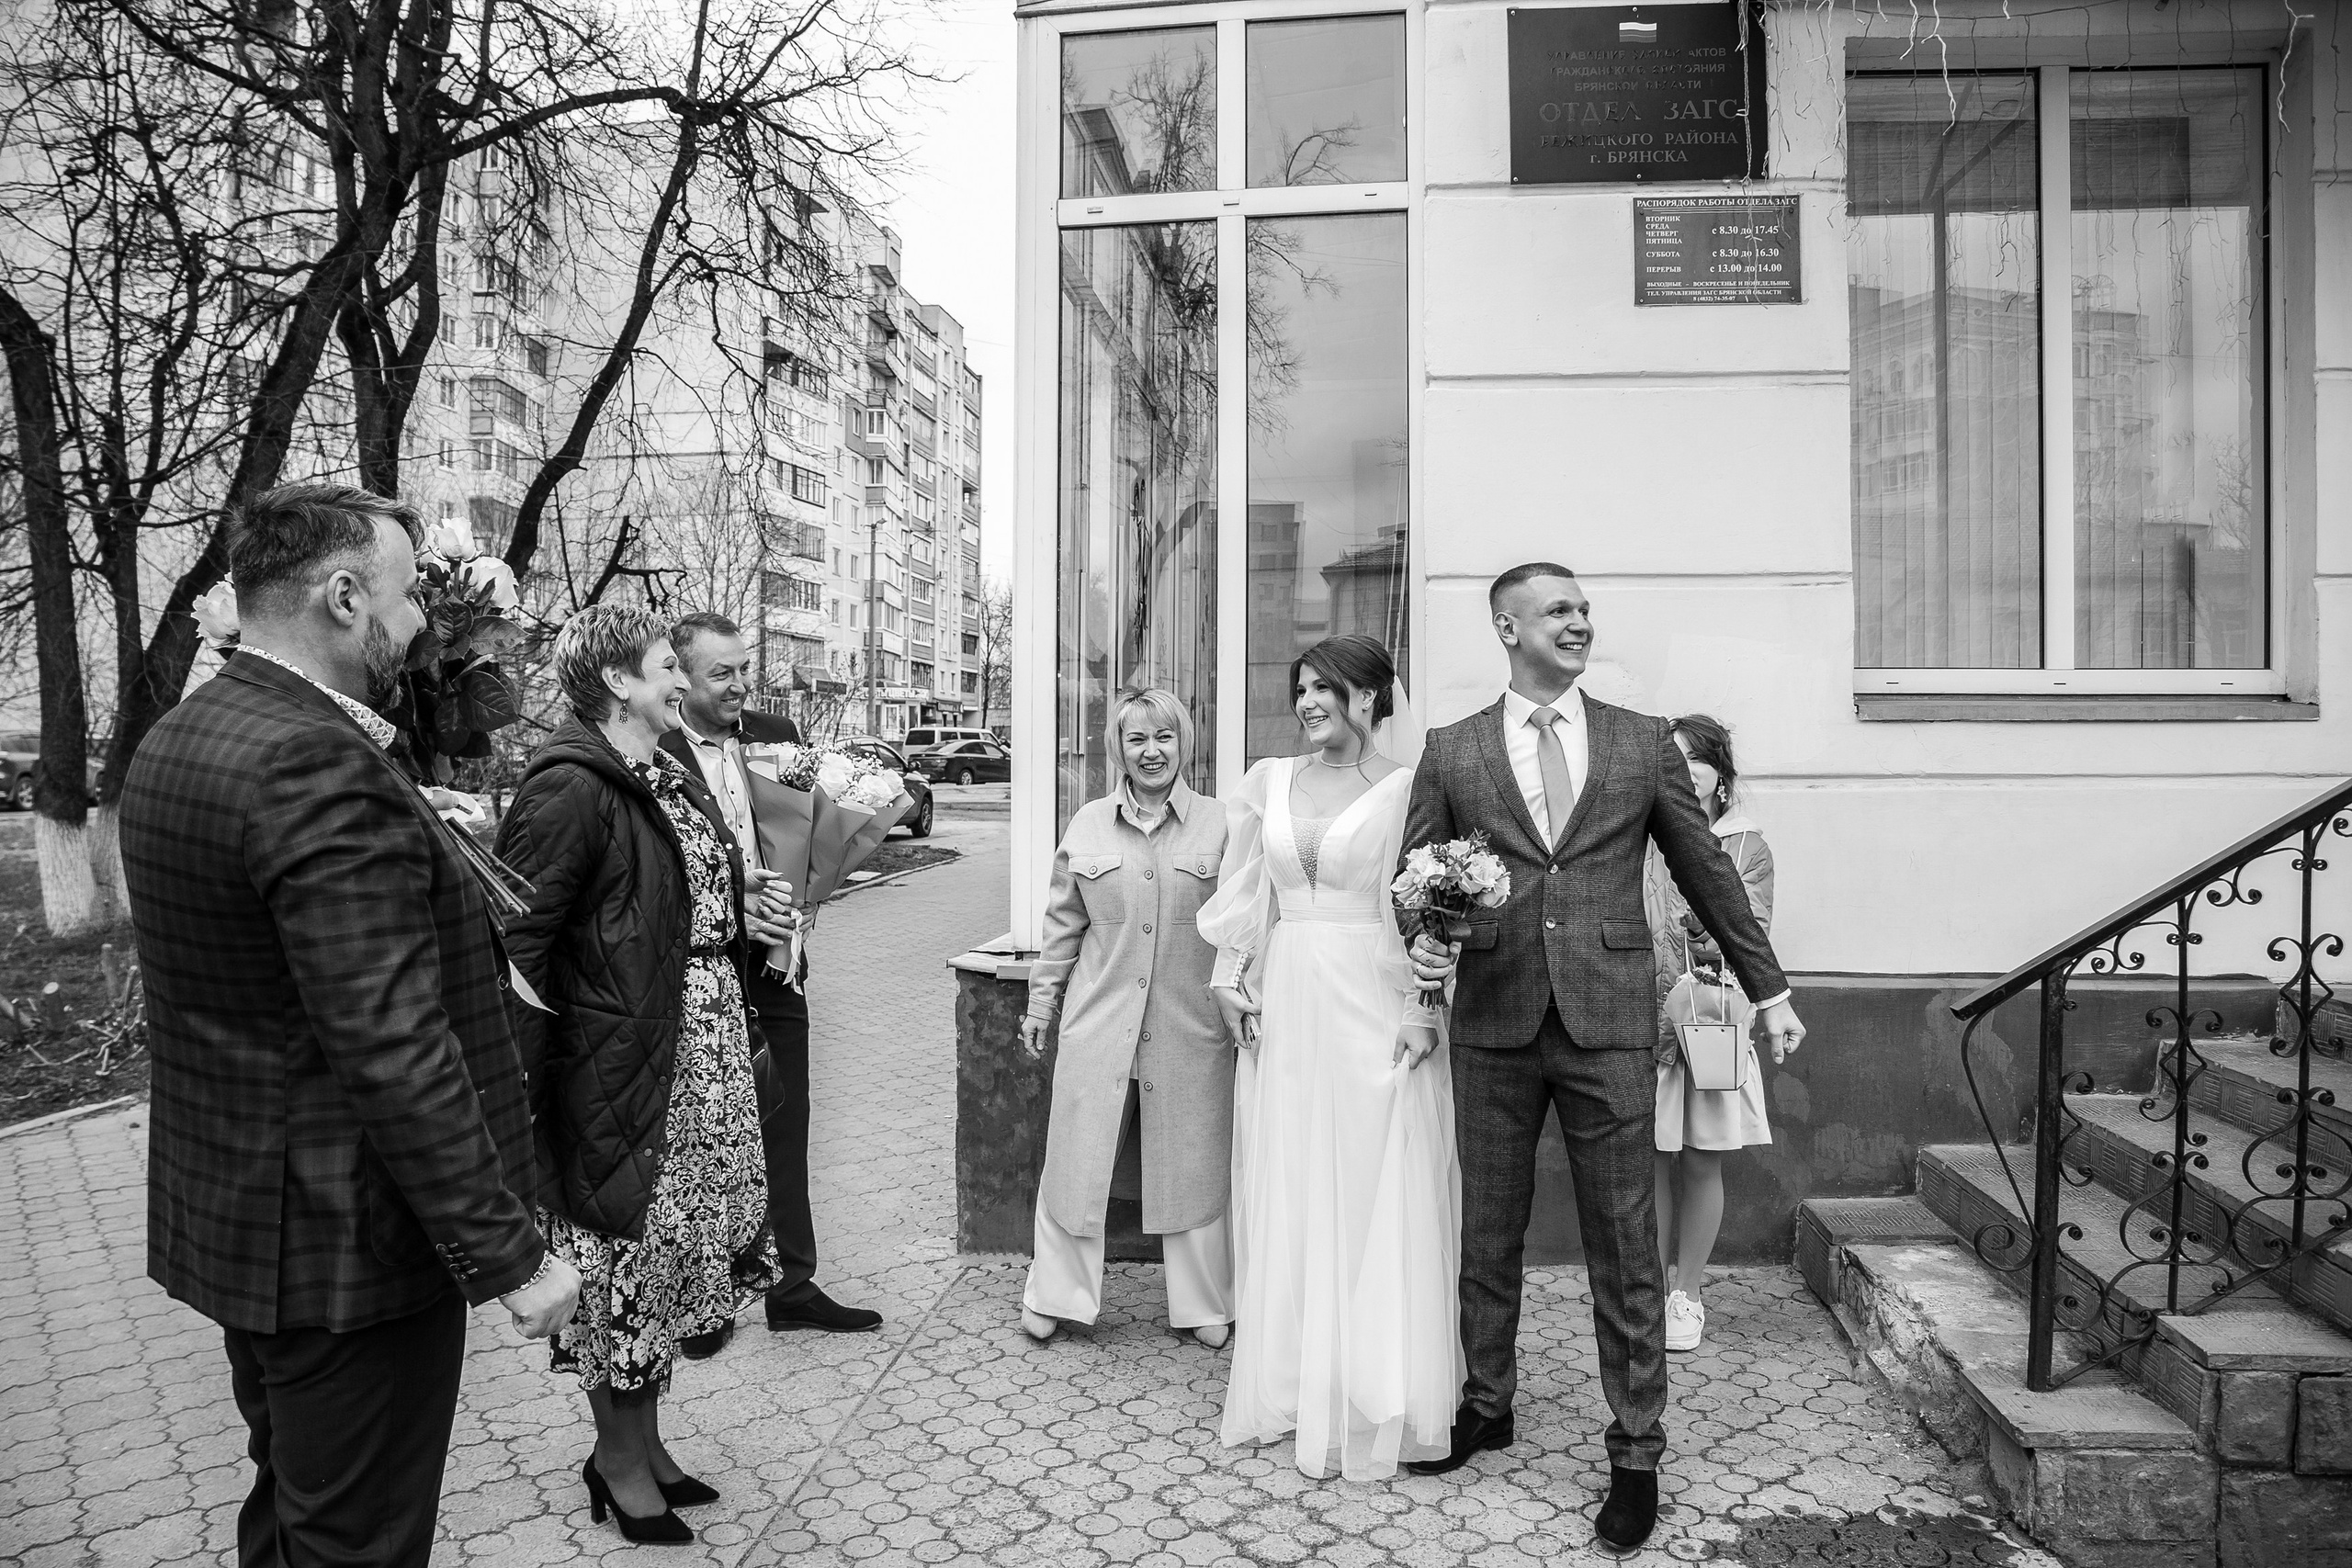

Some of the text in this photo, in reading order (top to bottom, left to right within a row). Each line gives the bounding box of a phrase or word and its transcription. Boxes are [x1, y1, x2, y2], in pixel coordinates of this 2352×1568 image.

[1547, 50, 1625, 62] УПРАВЛЕНИЕ
[1689, 48, 1726, 58] АКТОВ
[1550, 65, 1645, 77] ГРАЖДАНСКОГО
[1539, 98, 1738, 125] ОТДЕЛ ЗАГС
[1541, 130, 1739, 149] БЕЖИЦКОГО РАЙОНА
[1589, 150, 1689, 164] г. БРЯНСКА
[1636, 197, 1798, 208] РАСПОРЯДОК РАБОТЫ ОТДЕЛА ЗАГС
[1719, 226, 1738, 234] 8.30
[1740, 227, 1752, 235] до
[1755, 225, 1779, 234] 17.45
[1719, 249, 1738, 257] 8.30
[1741, 250, 1752, 258] до
[1756, 248, 1780, 257] 16.30
[1718, 264, 1742, 272] 13.00
[1758, 264, 1782, 272] 14.00
